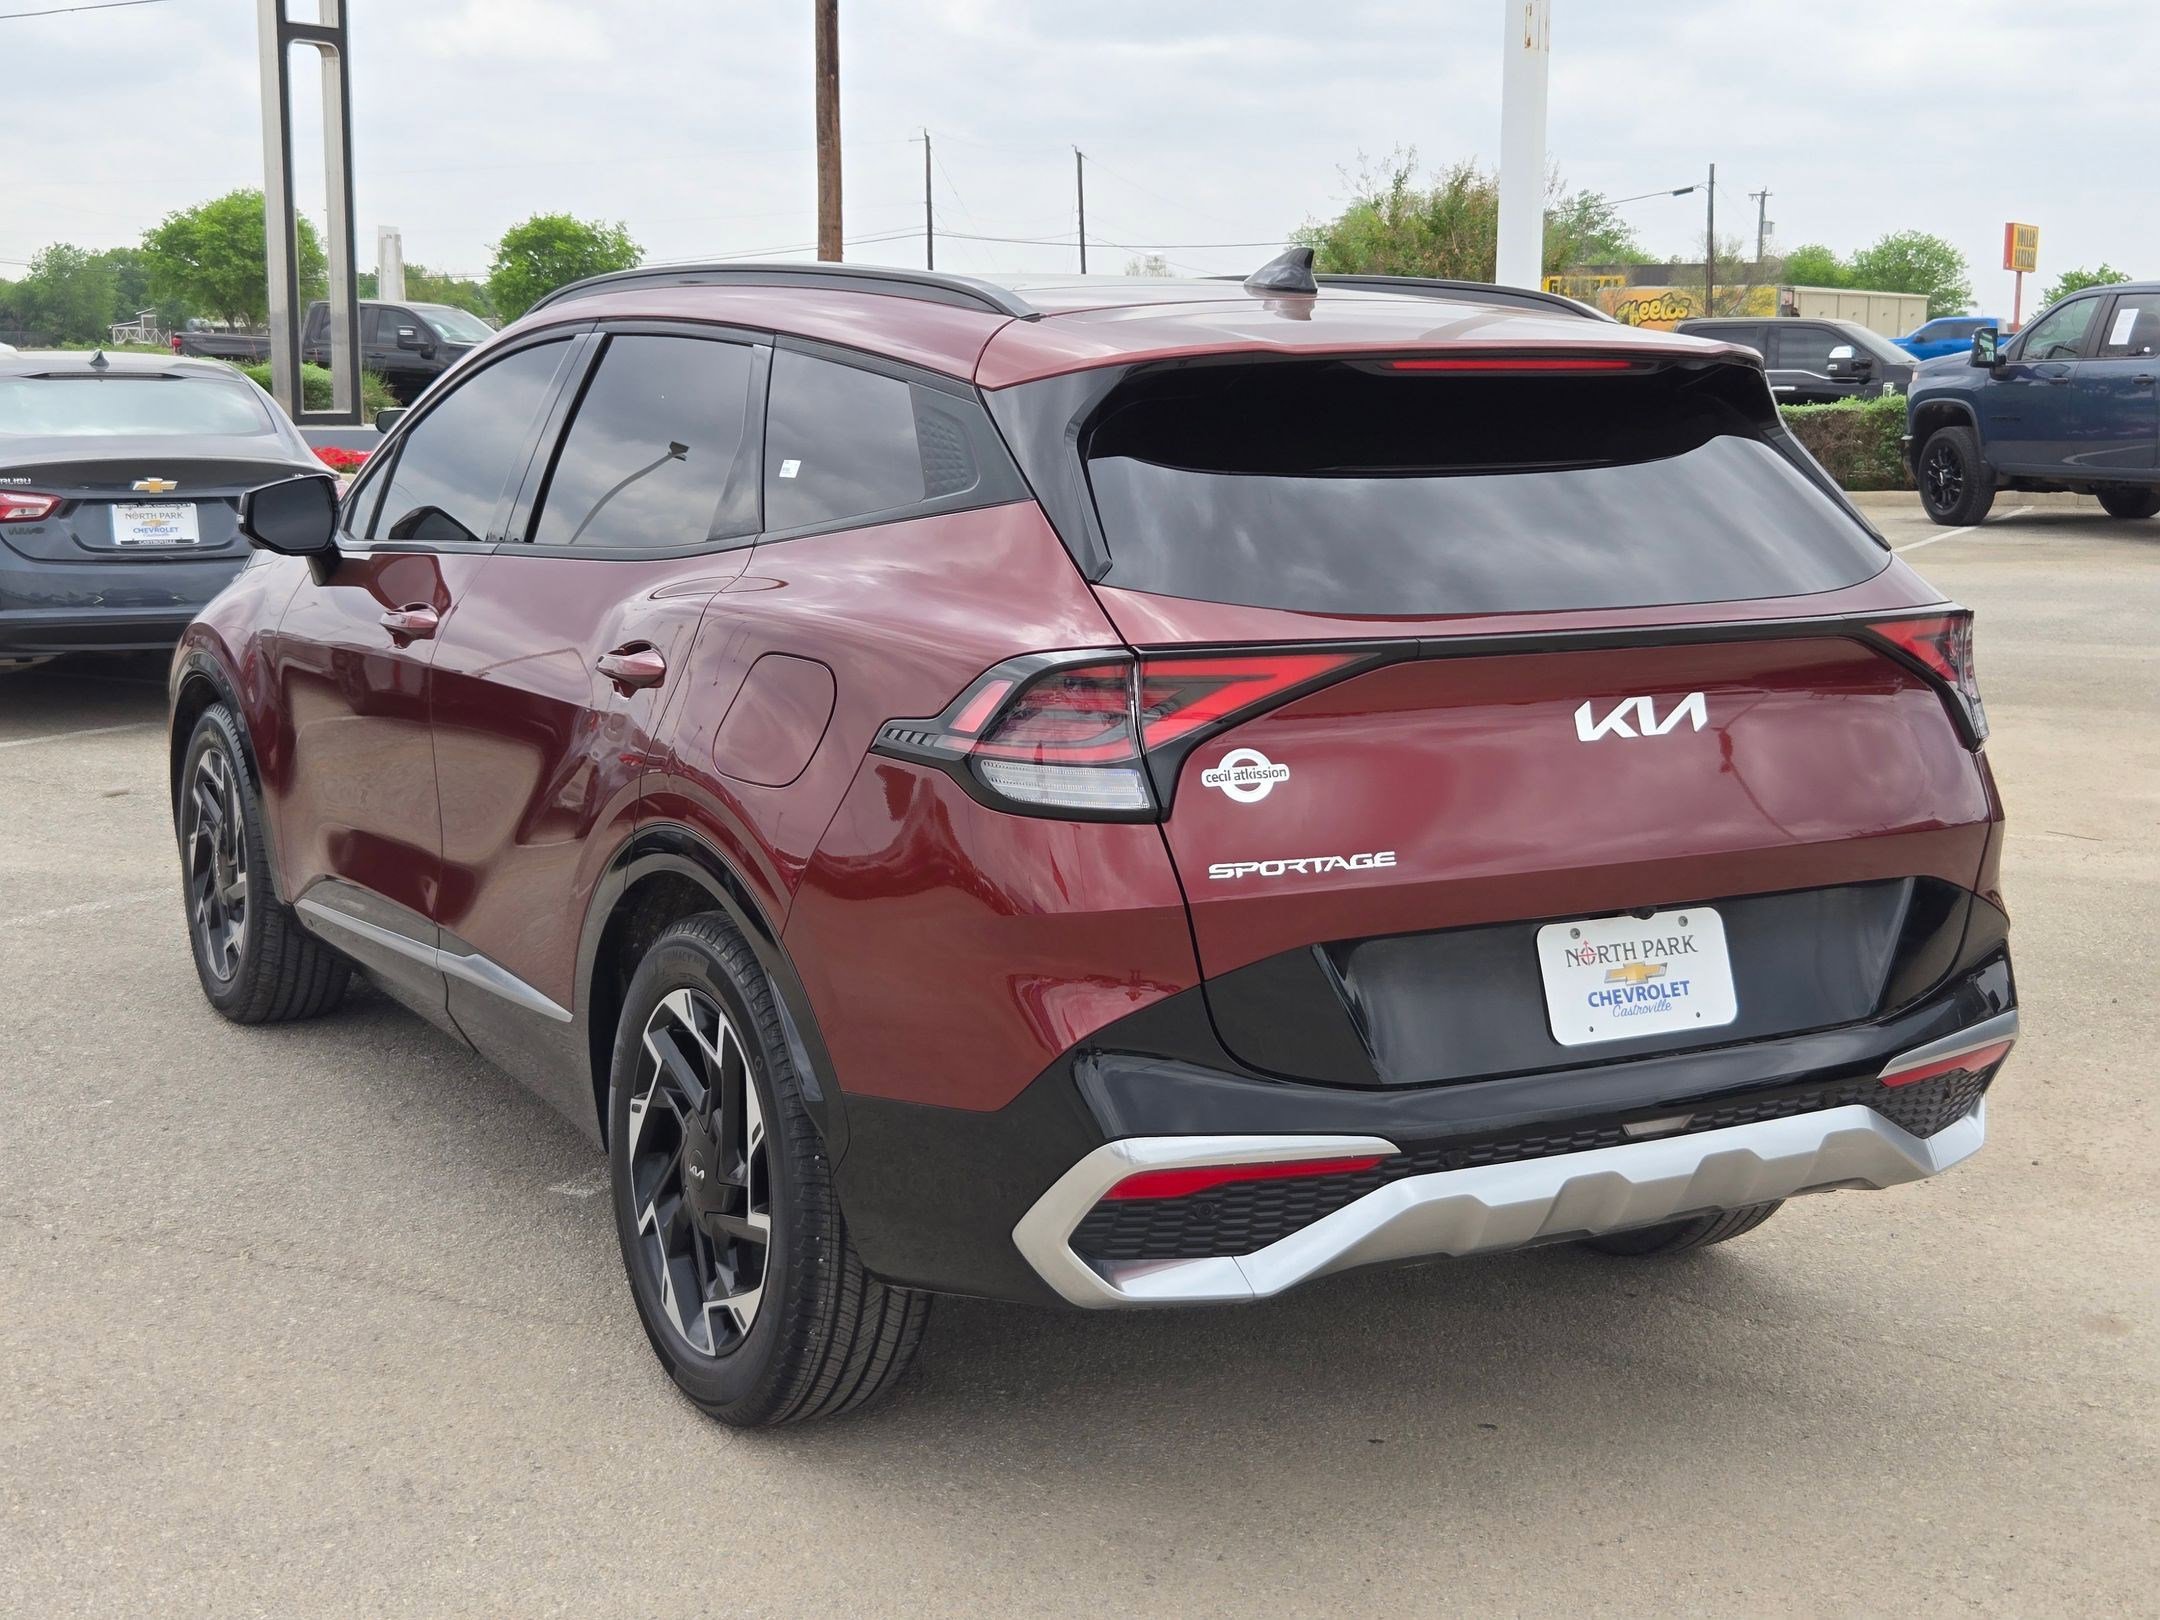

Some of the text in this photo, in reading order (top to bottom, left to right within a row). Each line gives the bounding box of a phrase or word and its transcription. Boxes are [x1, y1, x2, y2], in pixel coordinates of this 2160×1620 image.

[0, 477, 32, 485] ALIBU
[125, 511, 184, 520] NORTH PARK
[133, 526, 179, 534] CHEVROLET
[1574, 692, 1708, 742] KIA
[1205, 766, 1287, 783] cecil atkission
[1208, 851, 1397, 879] SPORTAGE
[1565, 934, 1699, 968] NORTH PARK
[1588, 980, 1690, 1008] CHEVROLET
[1612, 999, 1672, 1018] Castroville
